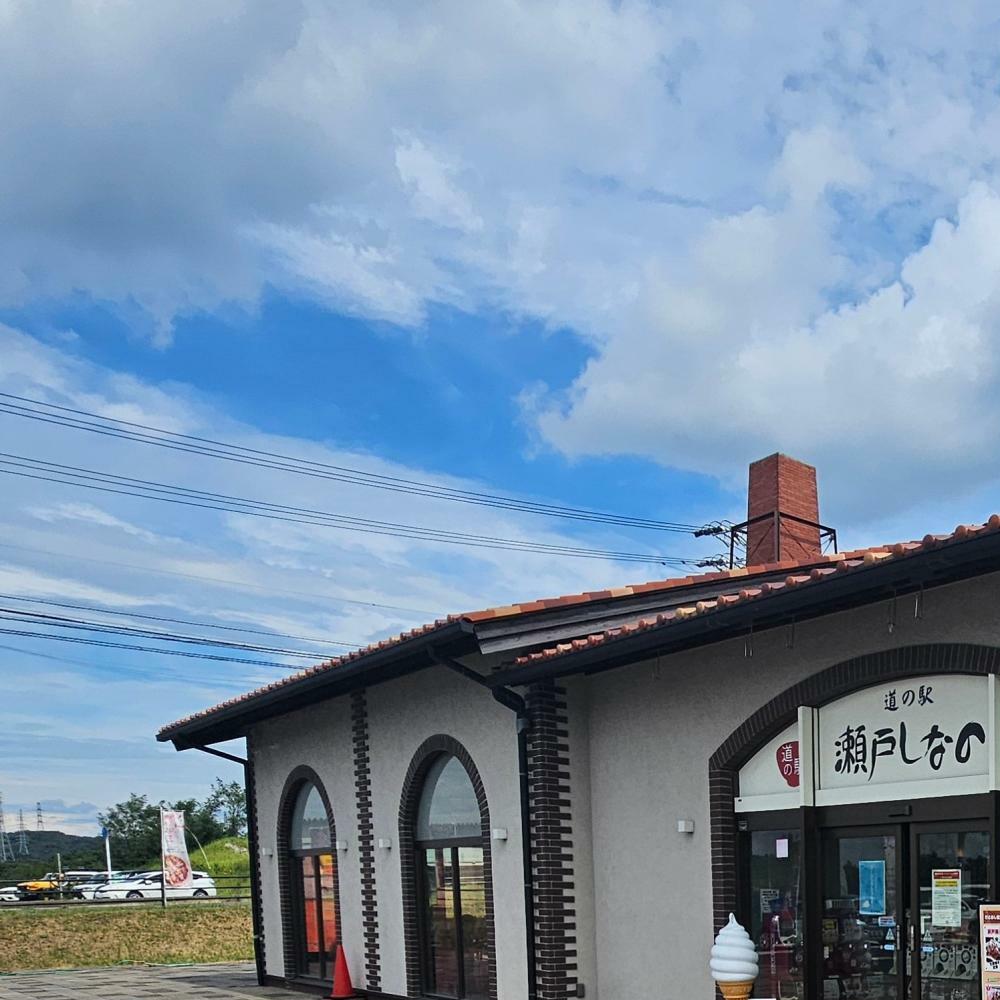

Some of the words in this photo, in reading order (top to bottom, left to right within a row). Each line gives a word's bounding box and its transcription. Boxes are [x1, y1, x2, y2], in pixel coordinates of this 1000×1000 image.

[884, 685, 934, 711] 道の駅
[834, 721, 986, 781] 瀬戸しなの
